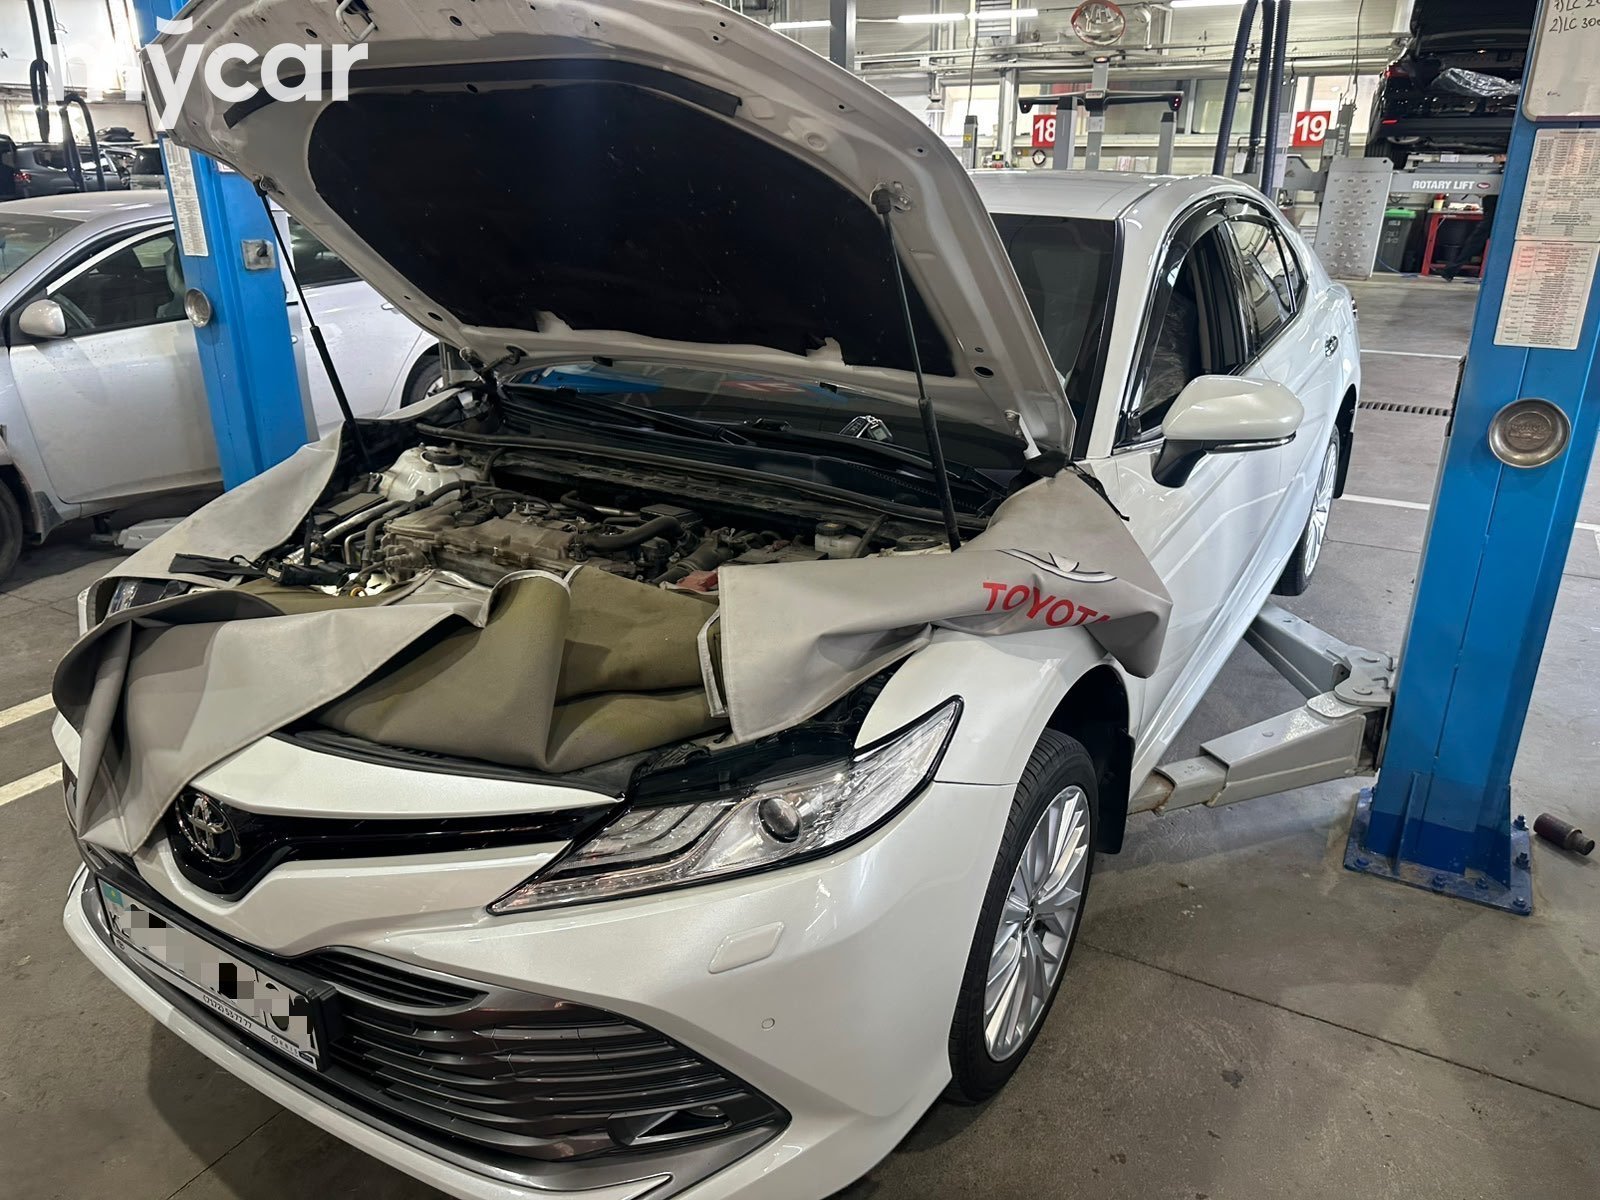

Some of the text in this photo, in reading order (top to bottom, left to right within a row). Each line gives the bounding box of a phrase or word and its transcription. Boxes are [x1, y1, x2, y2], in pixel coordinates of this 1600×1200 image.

[1034, 118, 1057, 143] 18
[1296, 115, 1328, 142] 19
[1412, 180, 1452, 190] ROTARY
[1453, 180, 1476, 190] LIFT
